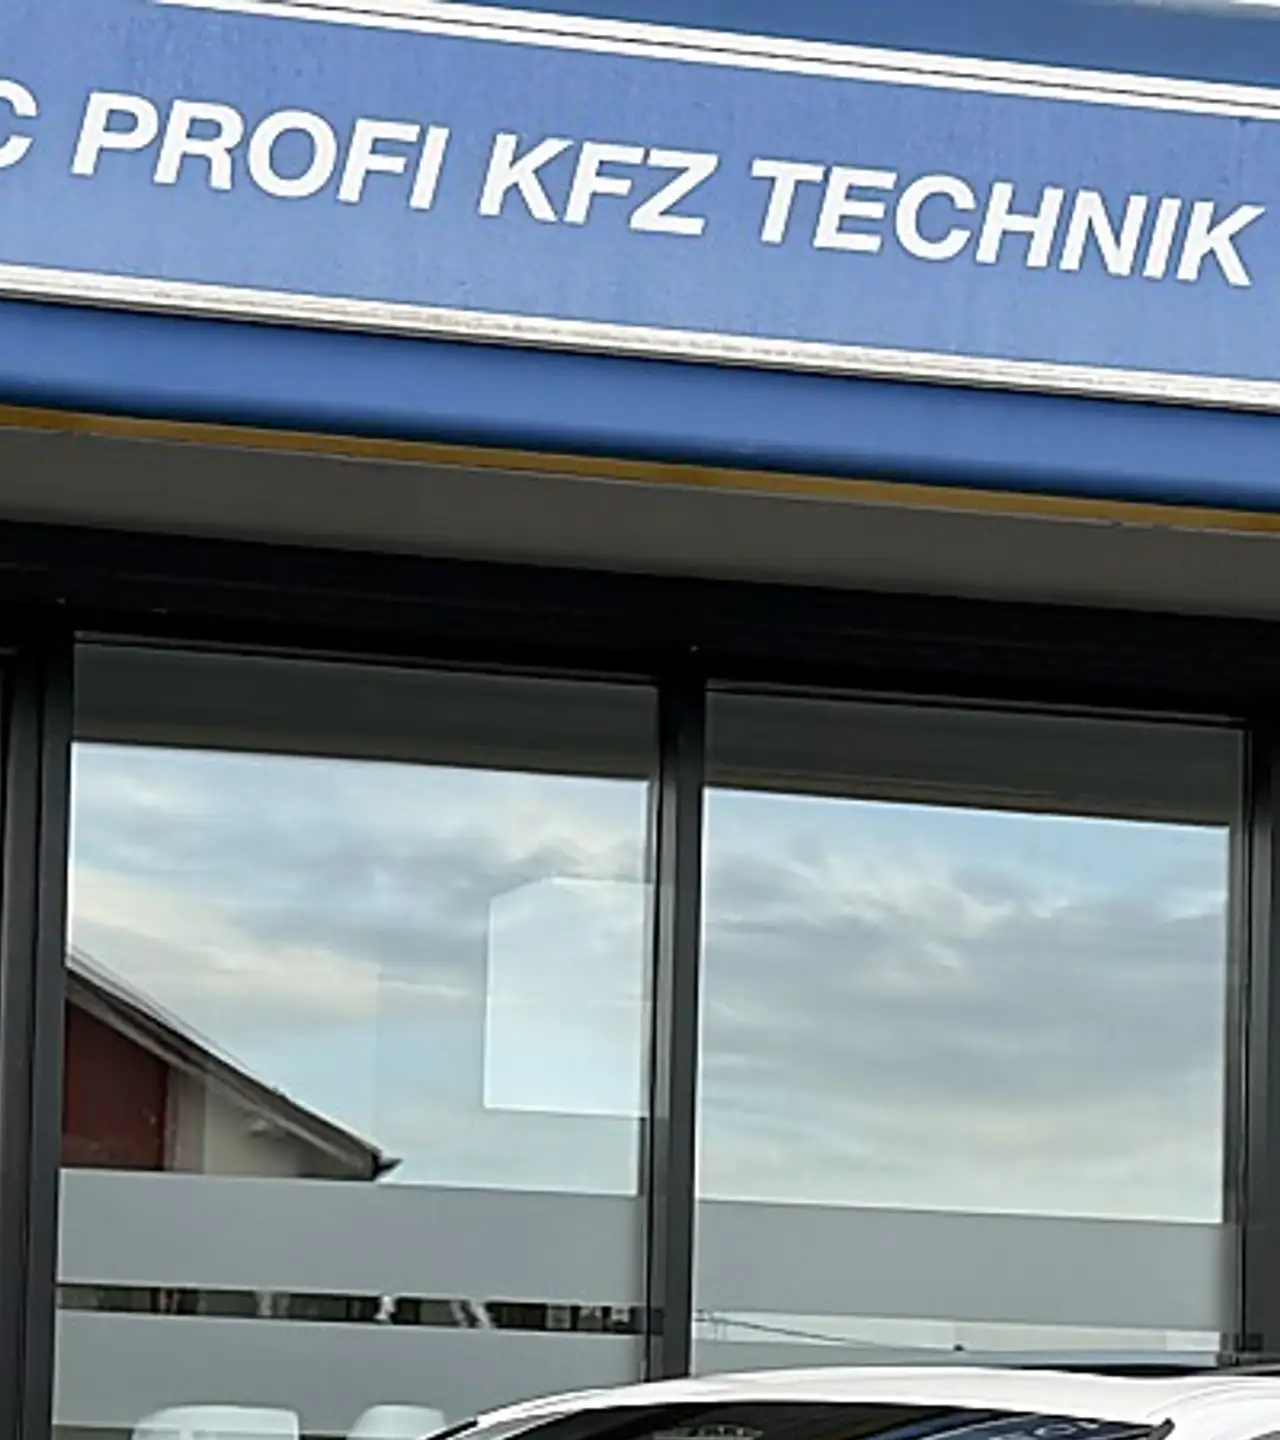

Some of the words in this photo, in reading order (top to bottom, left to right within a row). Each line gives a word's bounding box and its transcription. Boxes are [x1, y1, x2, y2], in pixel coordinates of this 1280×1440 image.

[73, 93, 449, 209] PROFI
[480, 134, 718, 235] KFZ
[752, 160, 1265, 286] TECHNIK
